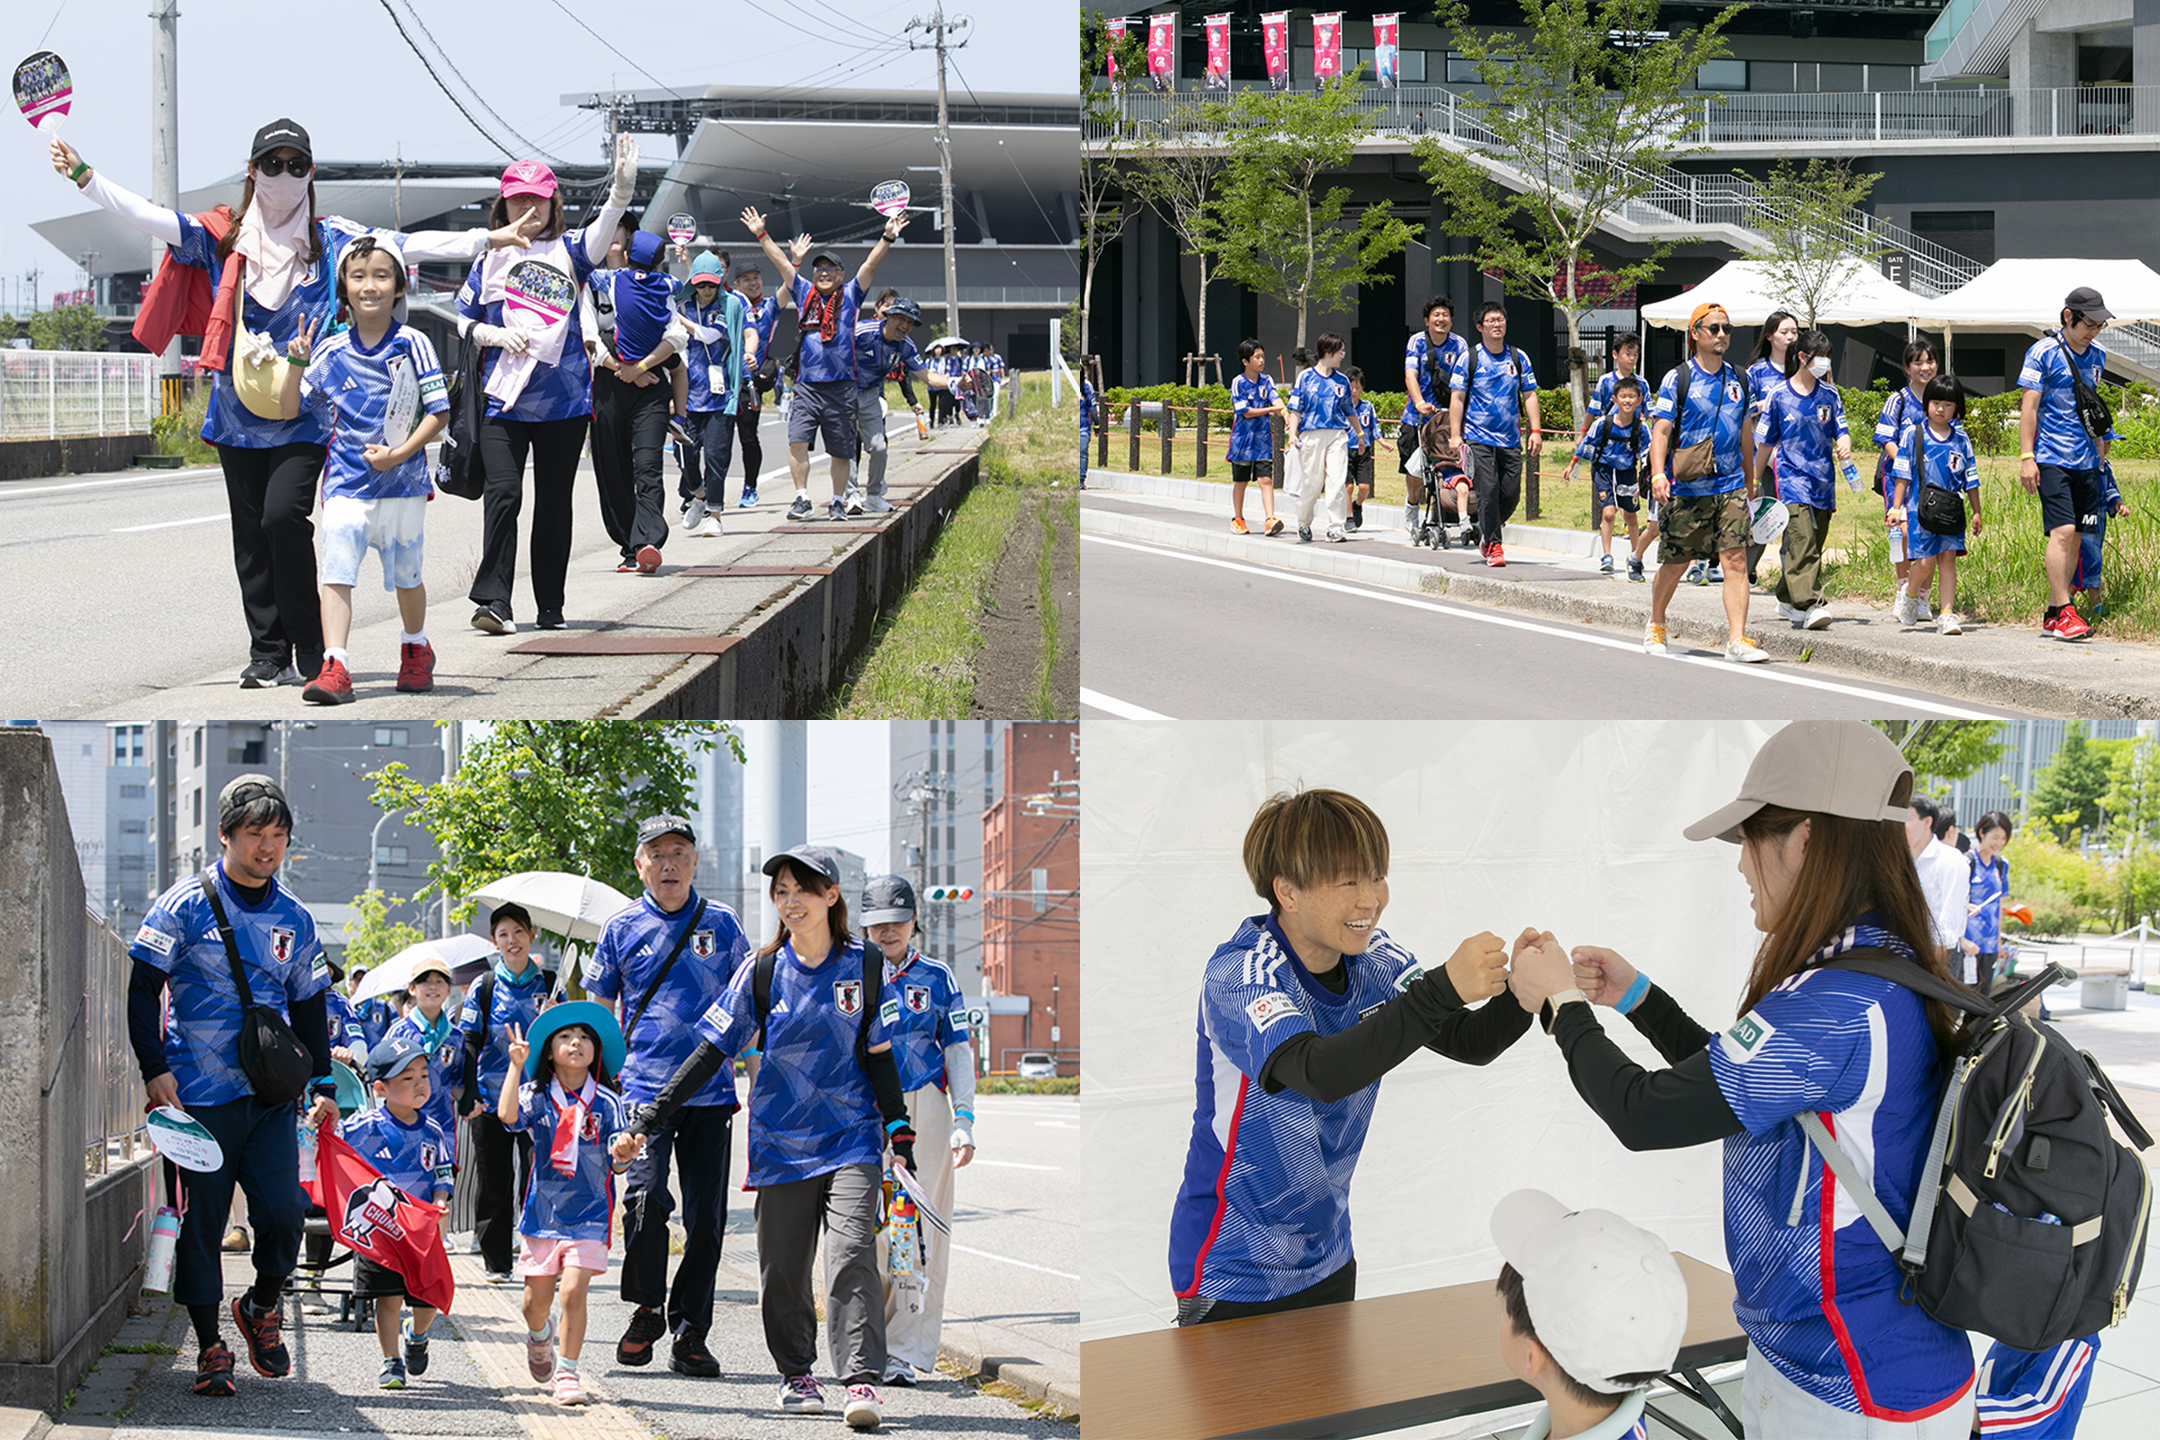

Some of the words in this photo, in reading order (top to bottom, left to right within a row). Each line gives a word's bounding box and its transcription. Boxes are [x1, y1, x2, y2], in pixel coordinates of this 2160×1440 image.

[1890, 266, 1902, 284] E
[971, 1010, 982, 1025] P
[366, 1204, 400, 1236] CHUMS
